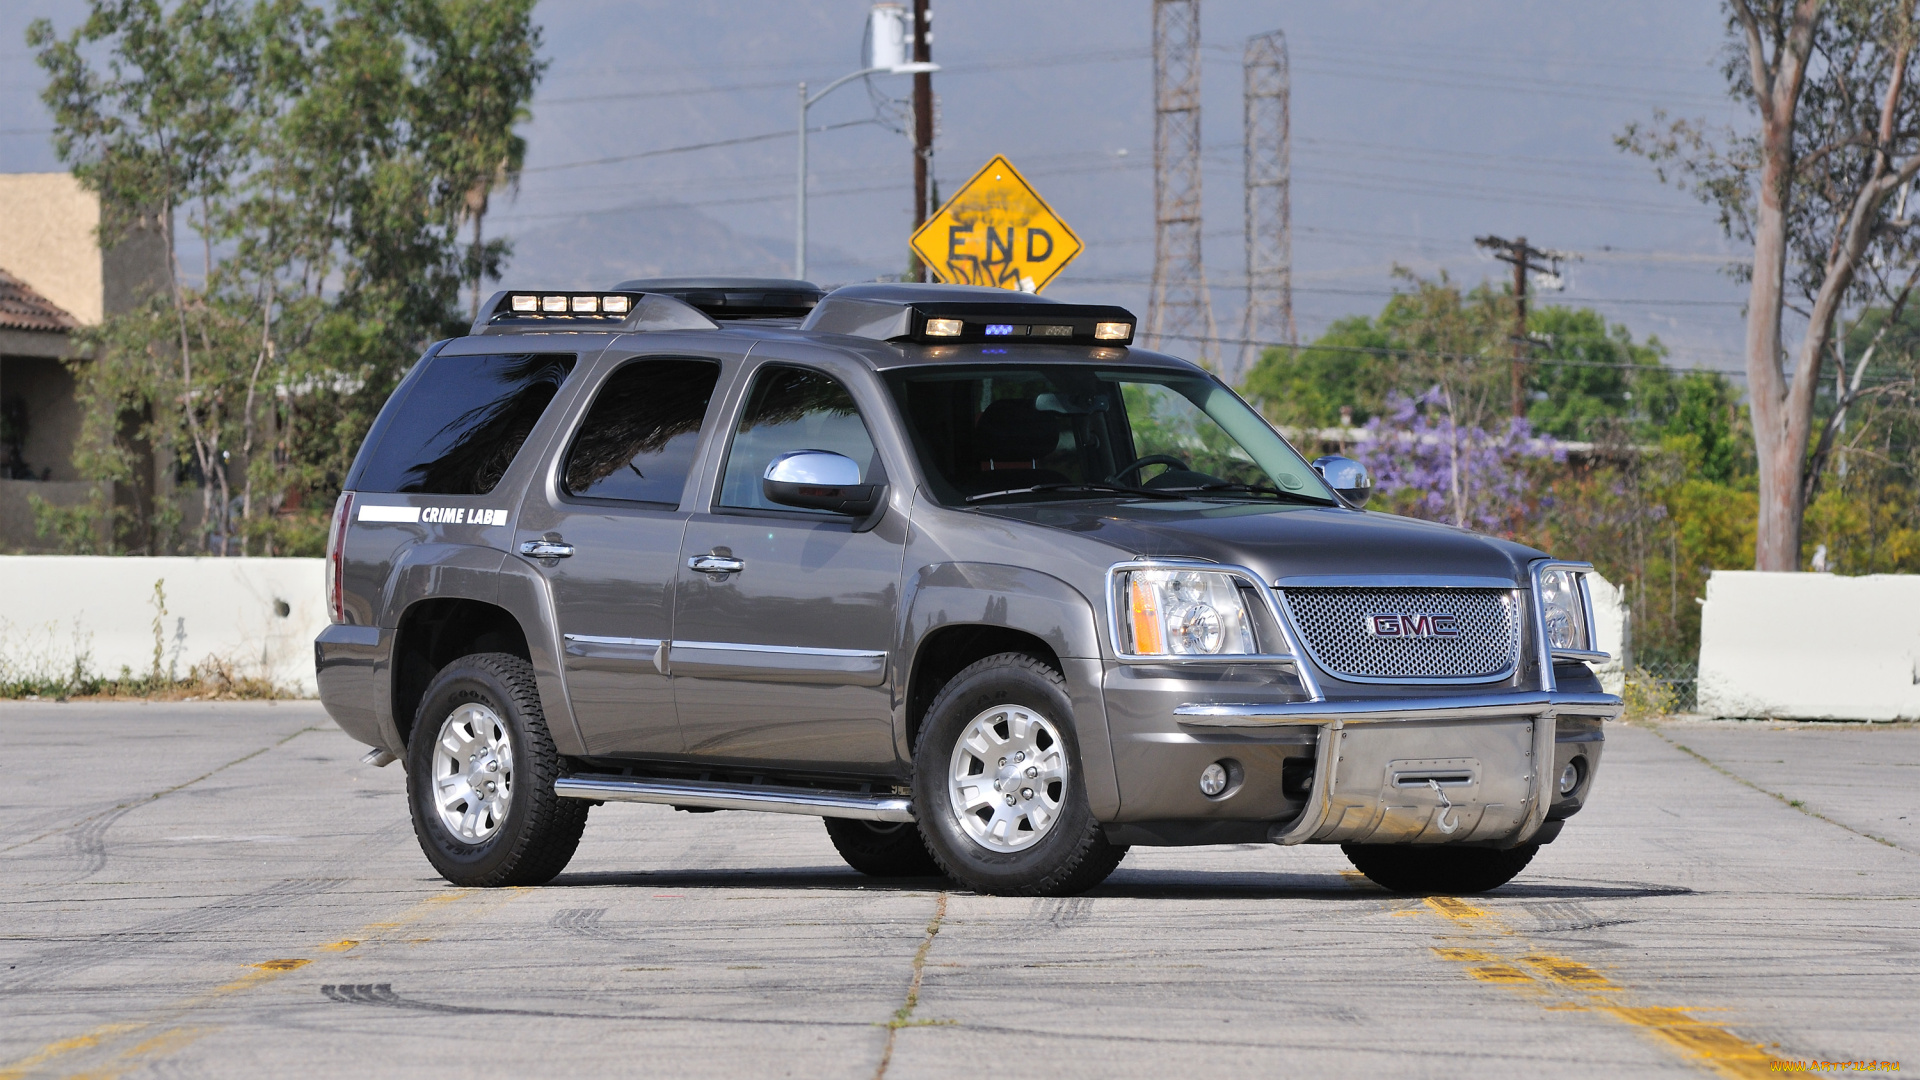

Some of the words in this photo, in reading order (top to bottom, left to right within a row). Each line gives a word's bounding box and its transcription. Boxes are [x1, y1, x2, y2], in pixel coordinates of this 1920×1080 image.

[949, 226, 1054, 262] END
[421, 507, 465, 524] CRIME
[466, 508, 494, 525] LAB
[1369, 613, 1459, 638] GMC
